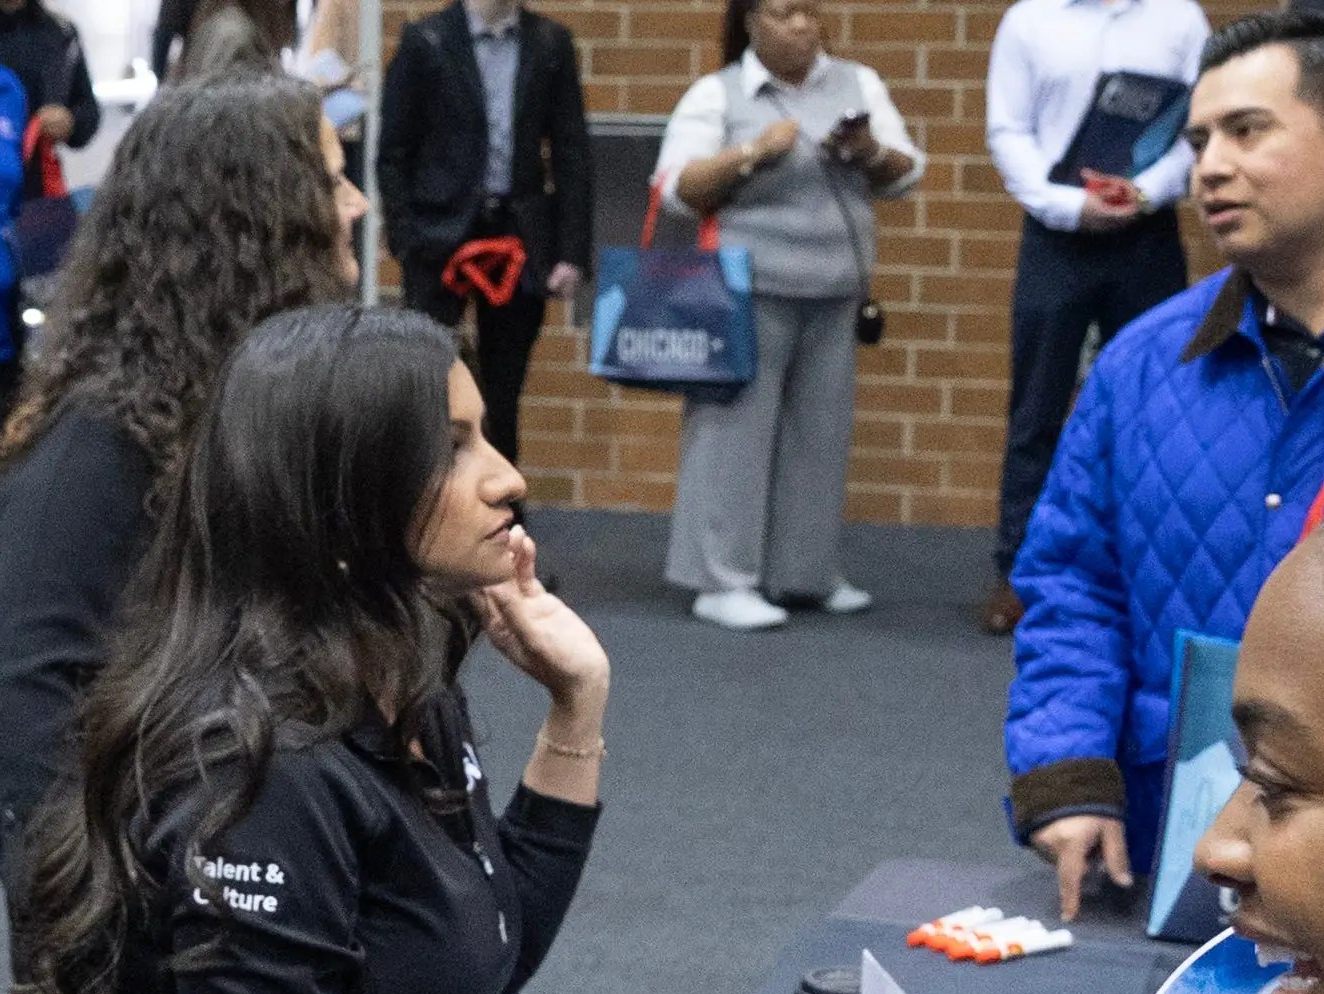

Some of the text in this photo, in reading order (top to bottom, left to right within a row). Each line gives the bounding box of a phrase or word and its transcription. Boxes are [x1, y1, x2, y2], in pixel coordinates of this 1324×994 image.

[193, 855, 285, 885] Talent &
[193, 886, 278, 912] Clture
